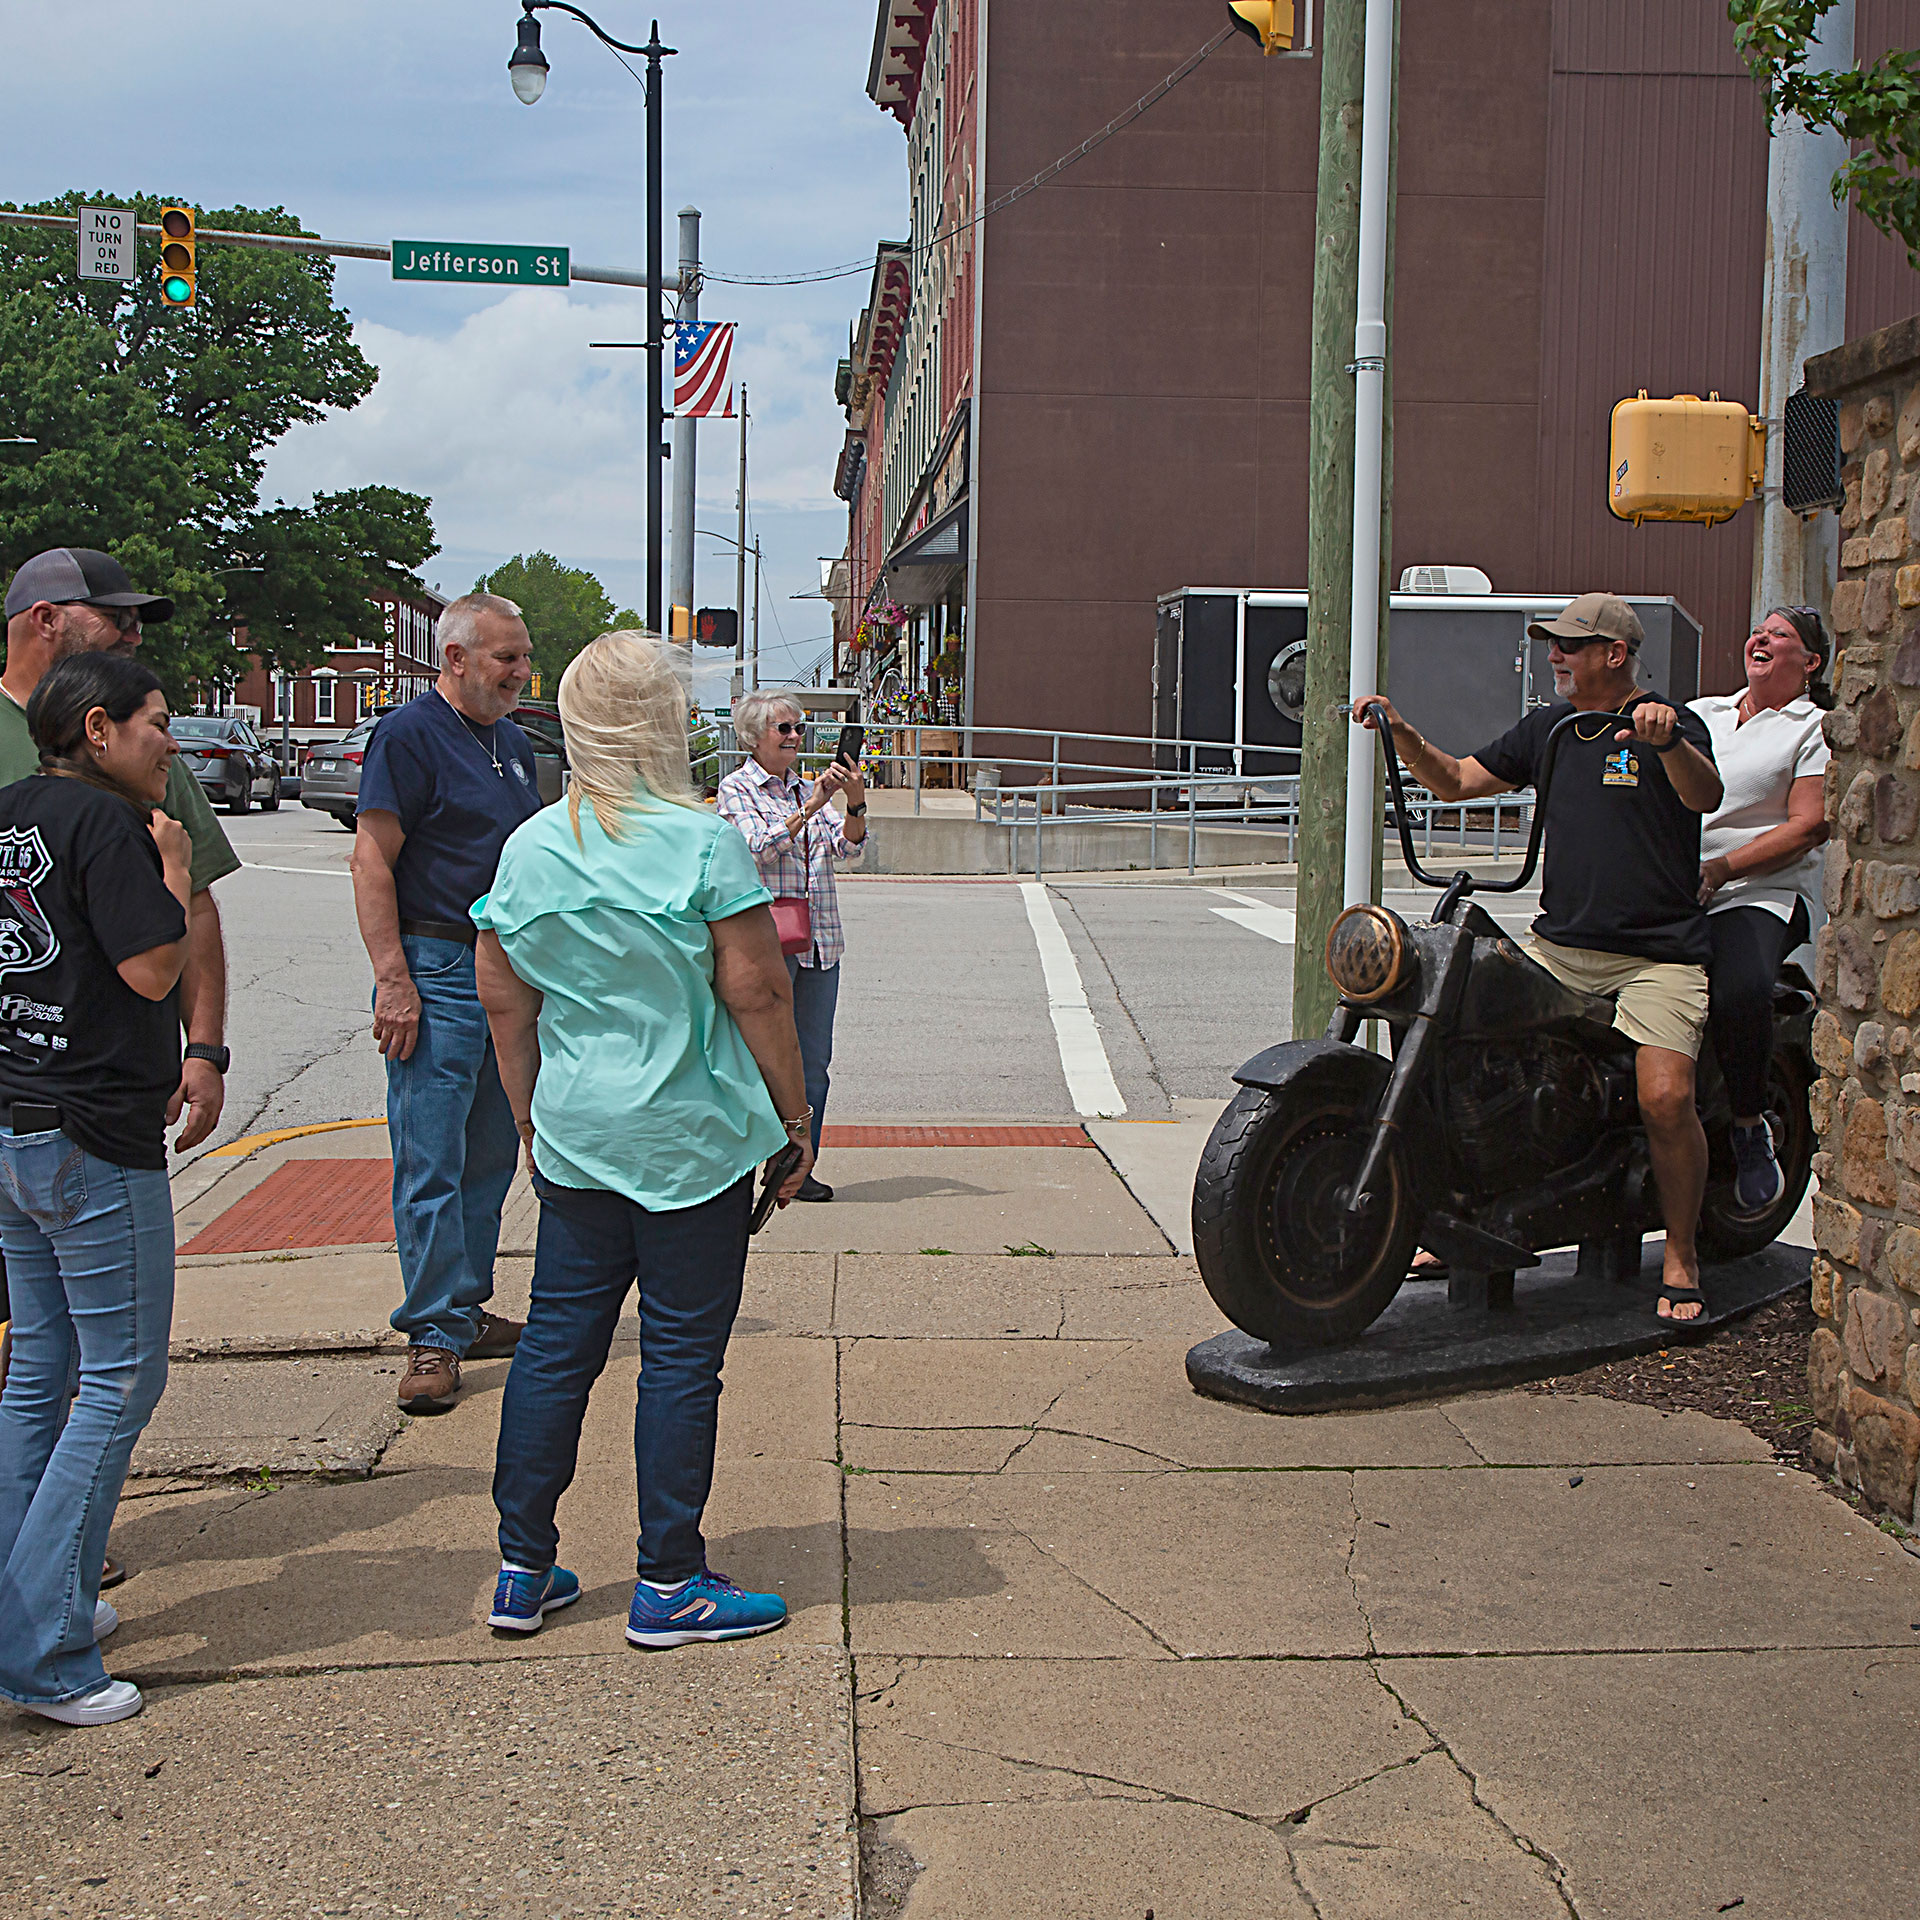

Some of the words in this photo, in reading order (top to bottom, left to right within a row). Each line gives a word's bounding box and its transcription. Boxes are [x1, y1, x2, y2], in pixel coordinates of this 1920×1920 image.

[95, 214, 121, 229] NO
[88, 231, 122, 245] TURN
[98, 247, 117, 259] ON
[95, 262, 120, 274] RED
[402, 250, 519, 275] Jefferson
[535, 255, 560, 277] St
